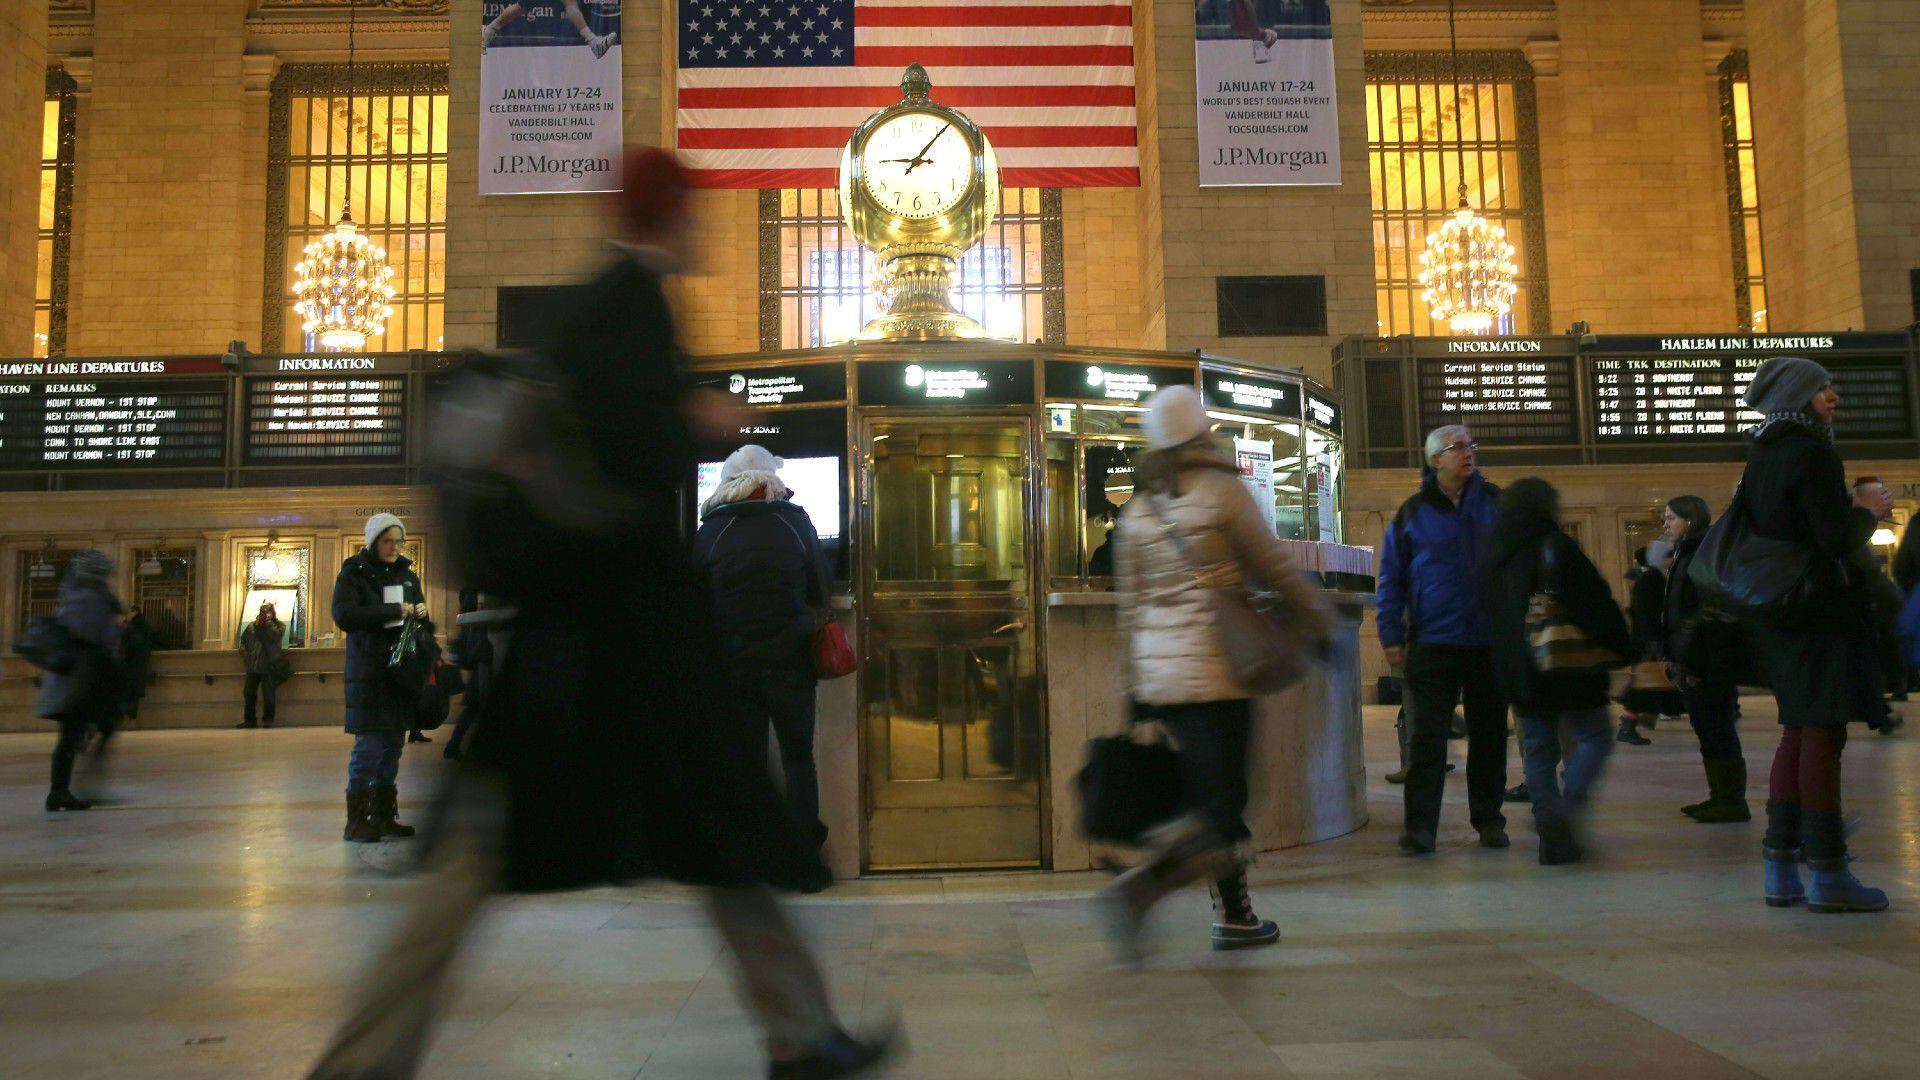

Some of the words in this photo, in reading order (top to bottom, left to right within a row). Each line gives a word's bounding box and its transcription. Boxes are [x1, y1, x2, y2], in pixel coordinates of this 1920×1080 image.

[1217, 81, 1276, 93] JANUARY
[1280, 81, 1314, 92] 17-24
[502, 88, 563, 100] JANUARY
[566, 87, 602, 99] 17-24
[1203, 97, 1241, 106] WORLD'S
[1243, 98, 1264, 106] BEST
[1267, 97, 1301, 106] SQUASH
[1303, 96, 1330, 105] EVENT
[489, 104, 555, 113] CELEBRATING
[558, 104, 567, 112] 17
[570, 103, 600, 112] YEARS
[604, 102, 614, 111] IN
[1225, 111, 1283, 120] VANDERBILT
[1286, 110, 1310, 119] HALL
[508, 118, 567, 127] VANDERBILT
[570, 117, 595, 126] HALL
[1228, 125, 1309, 135] TOCSQUASH.COM
[510, 132, 592, 142] TOCSQUASH.COM
[1213, 147, 1328, 171] J.P.Morgan
[493, 155, 611, 179] J.P.Morgan
[894, 192, 902, 205] 7
[914, 196, 922, 210] 6
[1448, 341, 1541, 353] INFORMATION
[1661, 338, 1717, 350] HARLEM
[1719, 338, 1750, 350] LINE
[1753, 337, 1834, 349] DEPARTURES
[0, 363, 43, 375] HAVEN
[46, 363, 78, 375] LINE
[81, 361, 165, 375] DEPARTURES
[279, 358, 375, 371] INFORMATION
[1444, 363, 1476, 373] Current
[1481, 363, 1513, 372] Service
[1517, 362, 1546, 372] Status
[1595, 360, 1621, 369] TIME
[1626, 360, 1649, 369] TRK
[1654, 359, 1721, 369] DESTINATION
[1735, 358, 1768, 368] REMA
[748, 376, 796, 387] Metropolitan
[1444, 377, 1477, 386] Hudson:
[1481, 376, 1515, 385] SERVICE
[1518, 375, 1547, 385] CHANGE
[1652, 373, 1694, 383] SOUTHEAST
[45, 383, 97, 394] REMARKS
[274, 381, 308, 391] Current
[312, 381, 347, 391] Service
[1667, 386, 1691, 395] WHITE
[1694, 386, 1723, 395] PLAINS
[312, 393, 346, 403] SERVICE
[350, 393, 380, 403] CHANGE
[1445, 389, 1477, 399] Harlem:
[1482, 389, 1515, 398] SERVICE
[1518, 388, 1547, 398] CHANGE
[46, 398, 71, 408] MOUNT
[75, 398, 105, 407] VERNON
[119, 397, 134, 407] 1ST
[137, 396, 158, 406] STOP
[1442, 403, 1457, 412] New
[1524, 401, 1552, 411] CHANGE
[1654, 399, 1696, 408] SOUTHEAST
[46, 412, 62, 421] NEW
[312, 407, 346, 417] SERVICE
[350, 406, 379, 416] CHANGE
[1669, 412, 1693, 421] WHITE
[1695, 411, 1725, 420] PLAINS
[45, 425, 71, 434] MOUNT
[74, 424, 104, 434] VERNON
[118, 423, 133, 433] 1ST
[135, 423, 157, 432] STOP
[354, 419, 384, 429] CHANGE
[1670, 425, 1694, 434] WHITE
[1697, 424, 1726, 433] PLAINS
[74, 438, 85, 447] TO
[87, 437, 114, 446] SHORE
[116, 436, 137, 446] LINE
[140, 436, 161, 445] EAST
[44, 451, 70, 461] MOUNT
[73, 450, 103, 460] VERNON
[117, 450, 132, 460] 1ST
[135, 449, 156, 459] STOP
